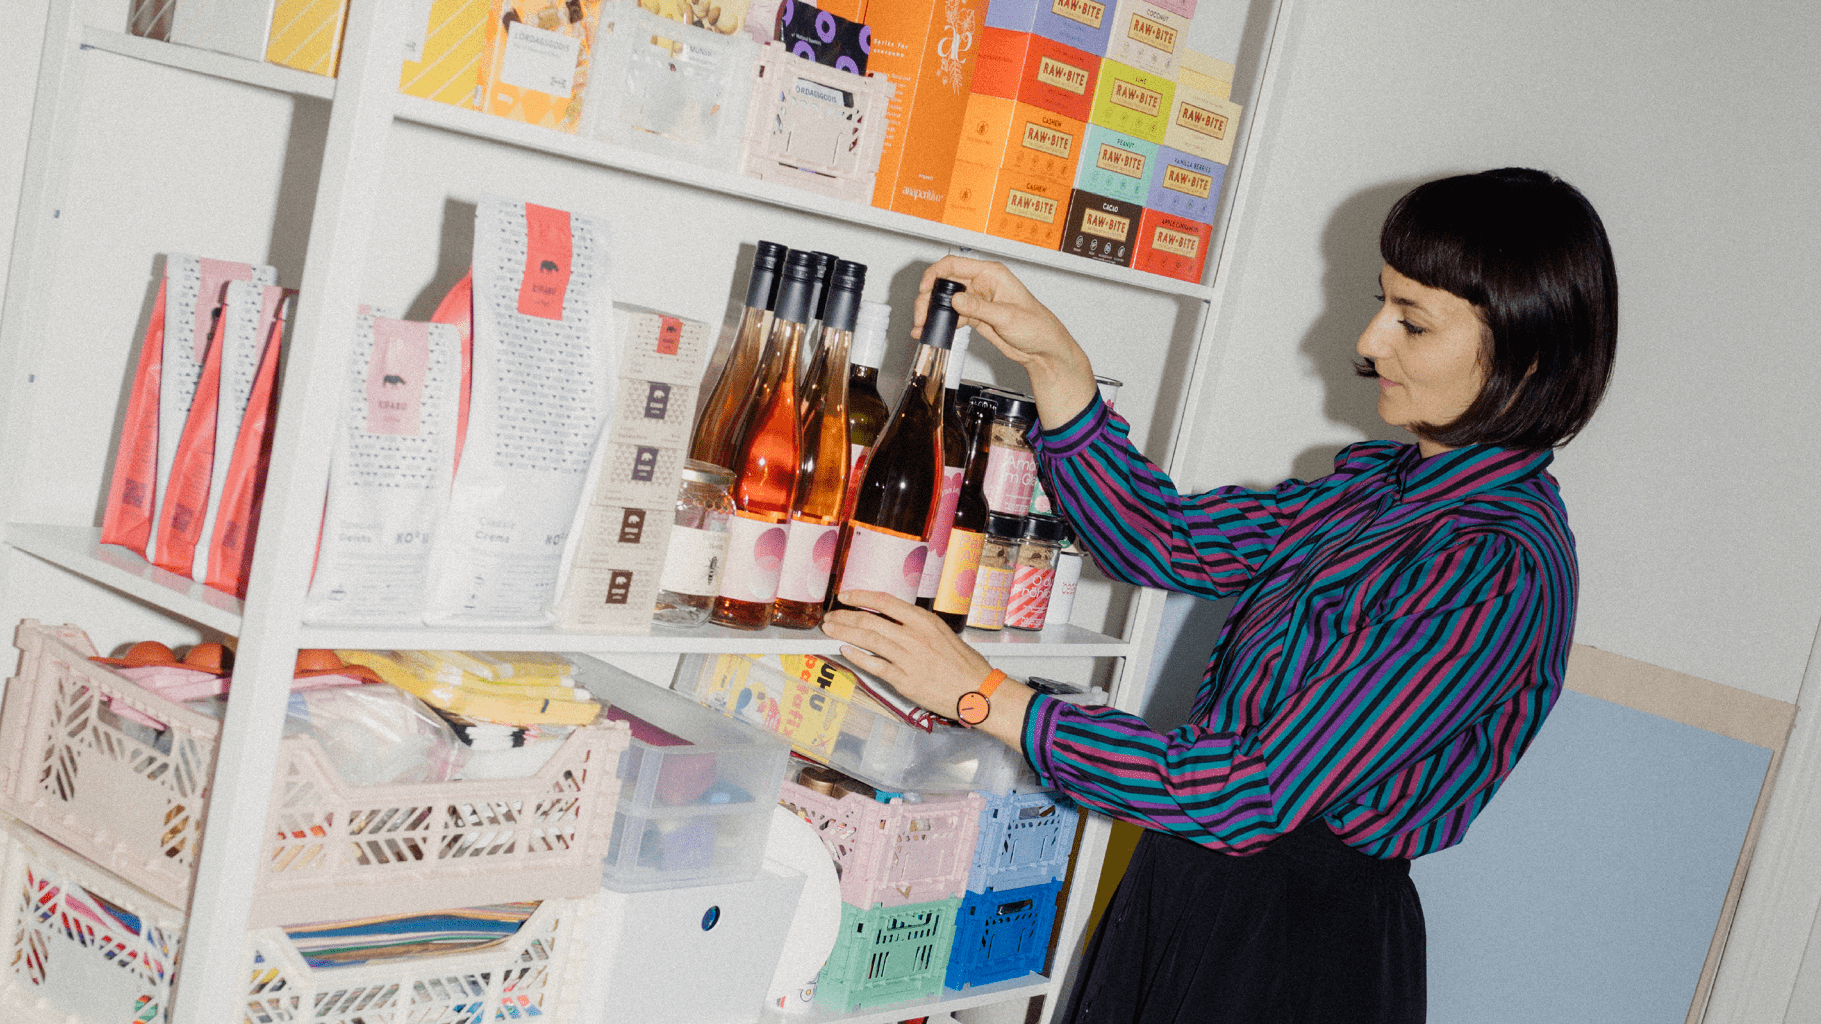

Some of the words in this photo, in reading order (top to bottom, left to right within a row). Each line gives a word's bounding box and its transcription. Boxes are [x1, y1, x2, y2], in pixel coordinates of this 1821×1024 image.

[1146, 8, 1169, 22] COCONUT
[873, 48, 904, 58] everyone
[1042, 116, 1062, 127] CASHEW
[1117, 138, 1135, 149] PEANUT
[1026, 182, 1047, 193] CASHEW
[1102, 202, 1119, 213] CACAO
[1162, 218, 1175, 228] APPLE
[809, 663, 838, 713] UHU
